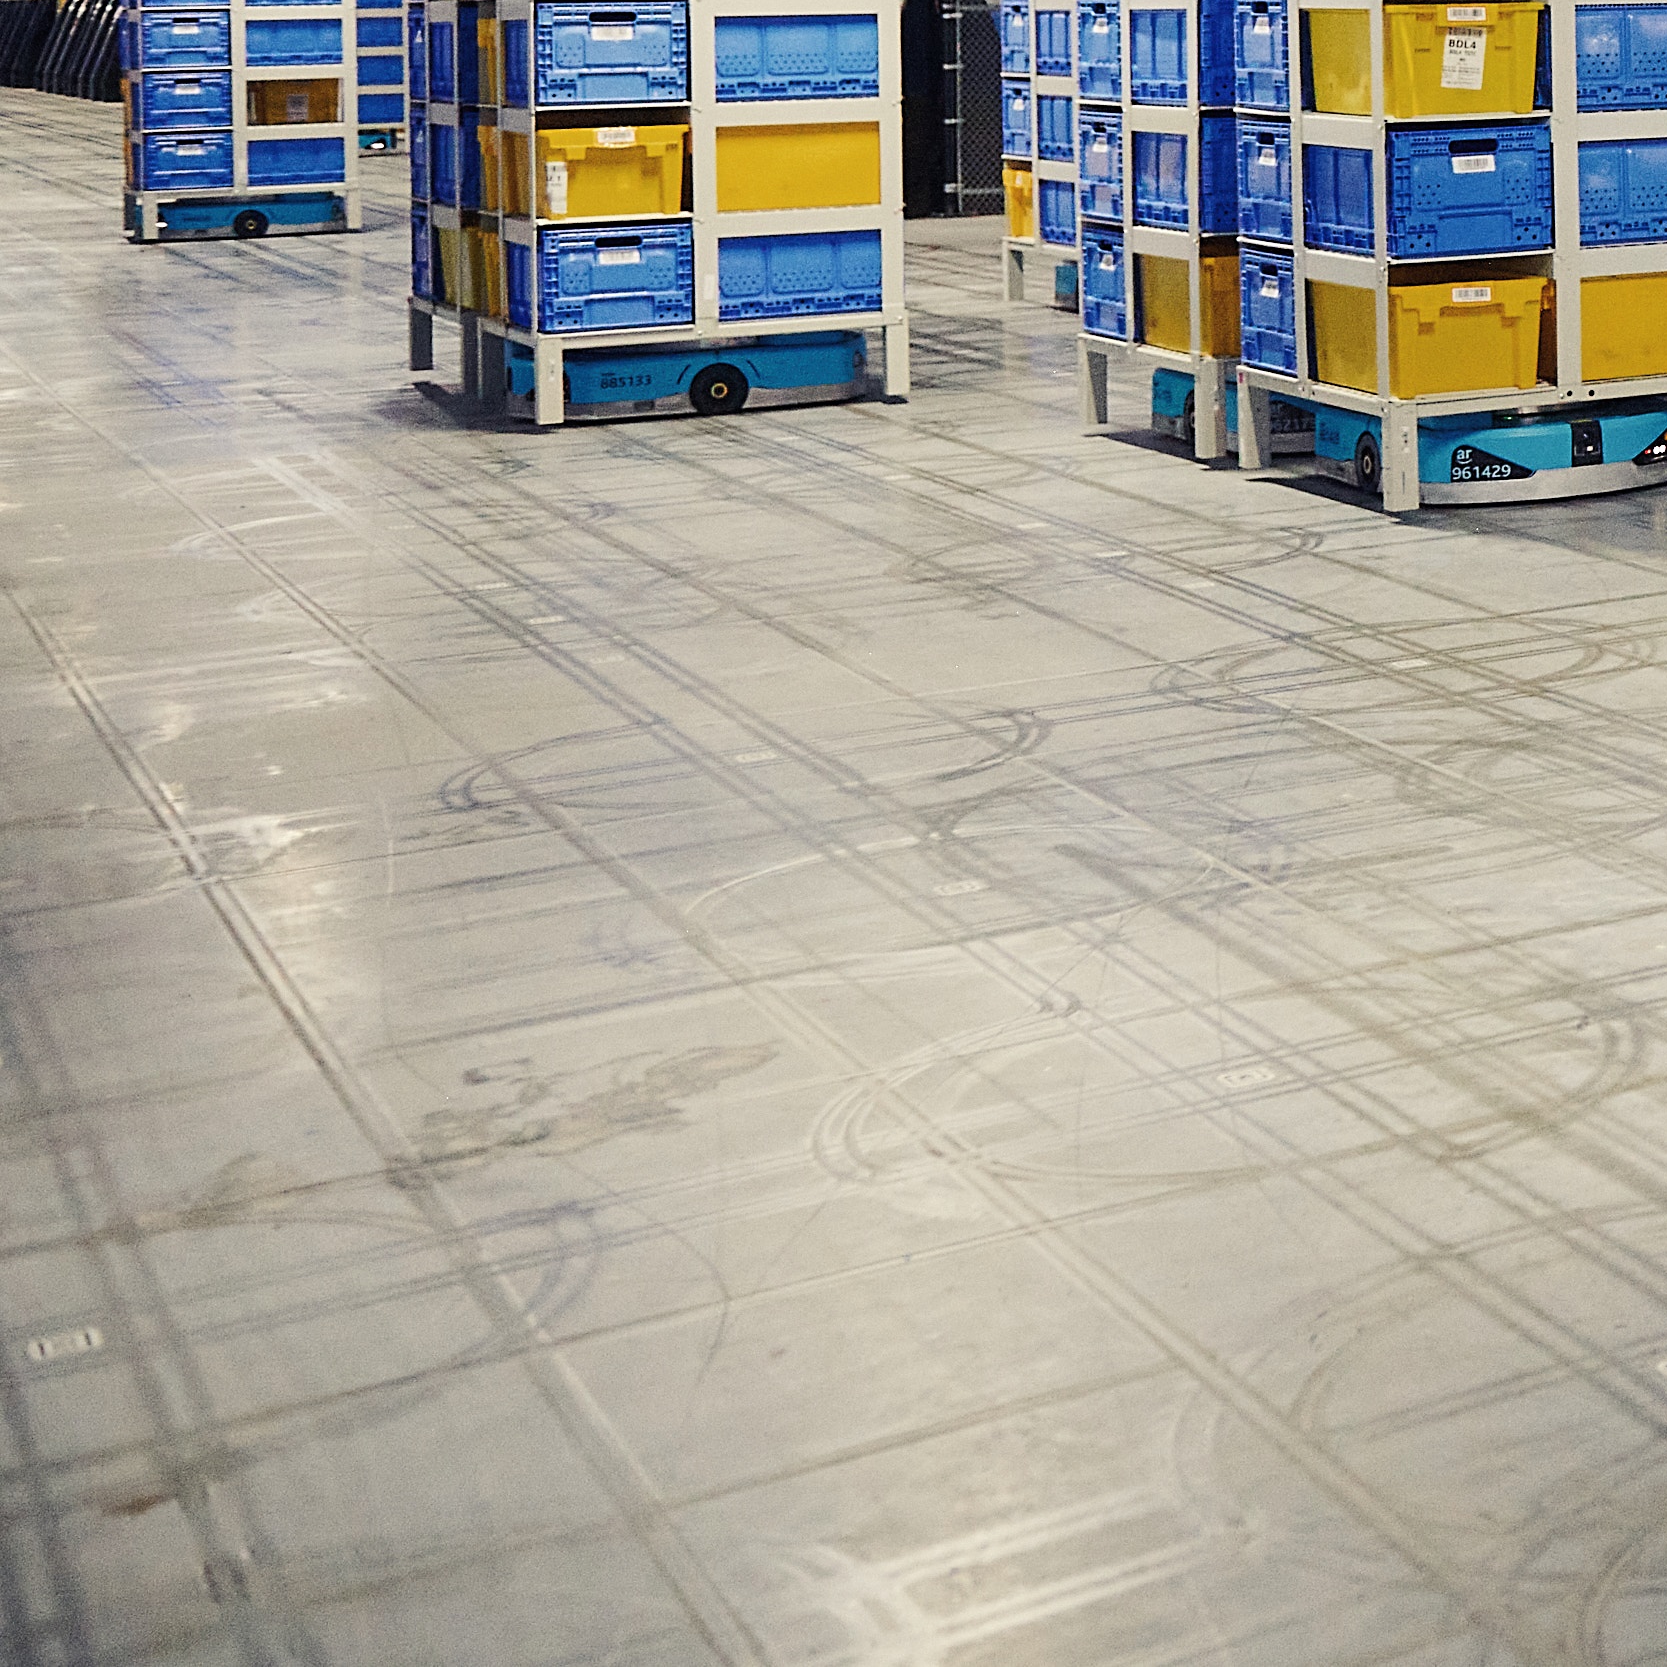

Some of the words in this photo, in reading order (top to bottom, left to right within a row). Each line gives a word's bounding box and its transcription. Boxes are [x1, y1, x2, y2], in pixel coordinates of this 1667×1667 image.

[1448, 39, 1477, 49] BDL4
[1456, 449, 1473, 460] ar
[1451, 464, 1512, 480] 961429
